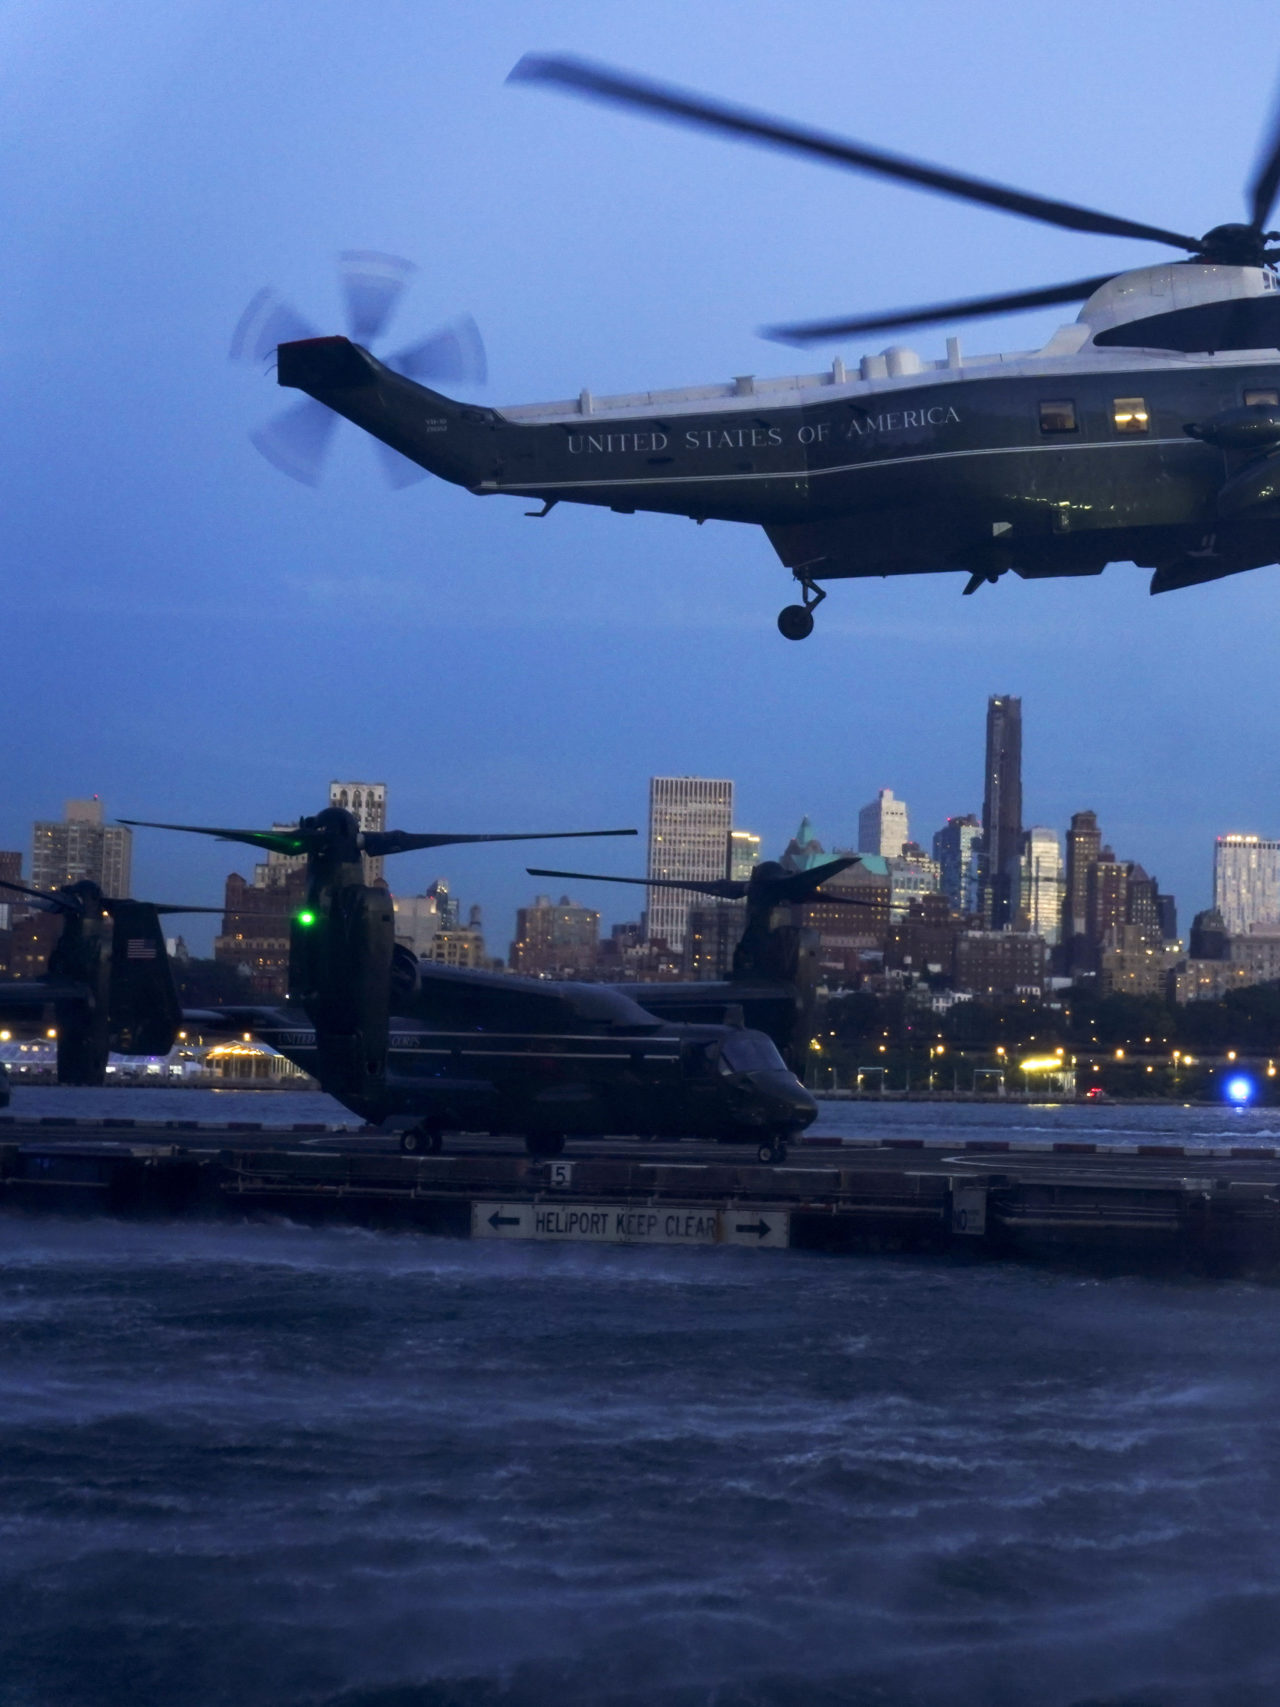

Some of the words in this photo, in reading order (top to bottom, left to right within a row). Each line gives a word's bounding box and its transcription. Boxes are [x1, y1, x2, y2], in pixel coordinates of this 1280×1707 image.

[568, 432, 668, 455] UNITED
[685, 427, 783, 450] STATES
[797, 423, 830, 445] OF
[846, 405, 962, 438] AMERICA
[556, 1166, 566, 1185] 5
[536, 1212, 609, 1234] HELIPORT
[616, 1214, 658, 1235] KEEP
[665, 1216, 716, 1238] CLEAR
